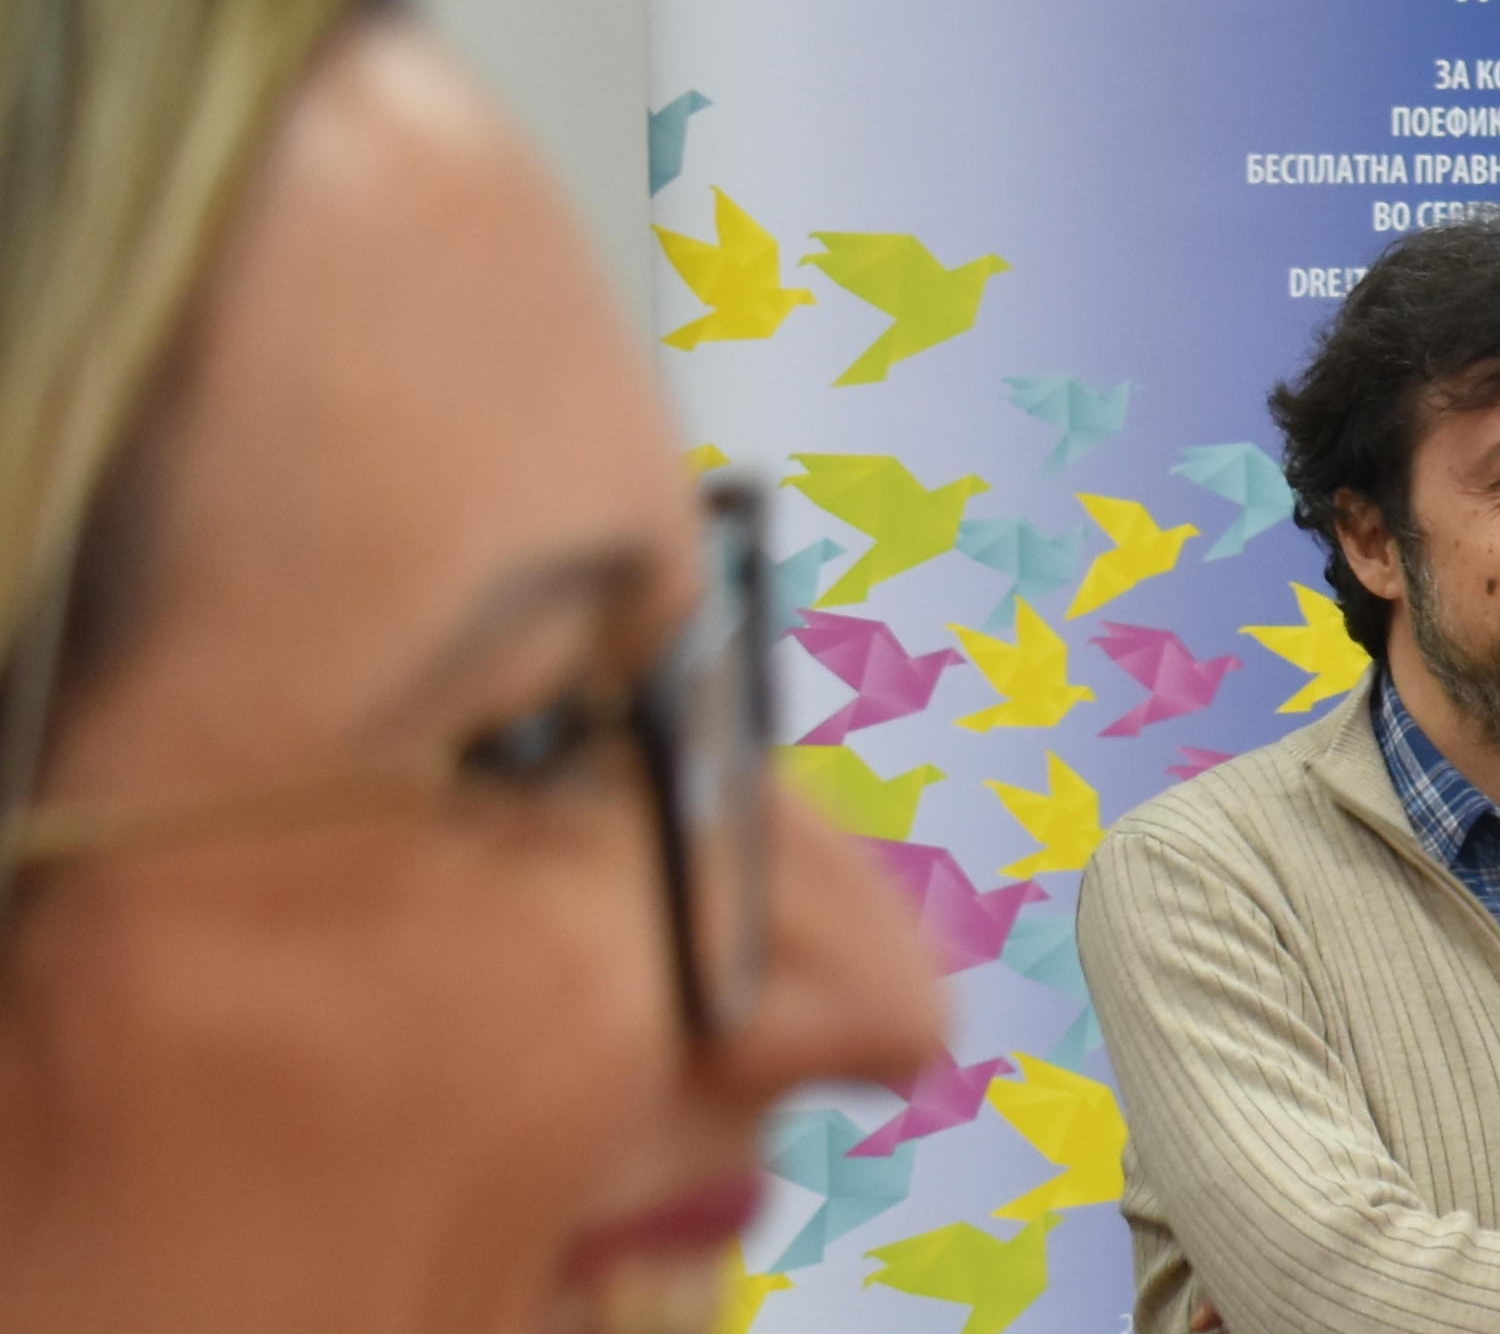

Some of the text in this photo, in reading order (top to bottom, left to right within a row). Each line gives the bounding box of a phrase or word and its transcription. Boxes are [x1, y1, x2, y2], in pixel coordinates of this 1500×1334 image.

[1435, 59, 1471, 91] ЗА
[1246, 153, 1408, 187] БЕСПЛАТНА
[1373, 201, 1411, 232] ВО
